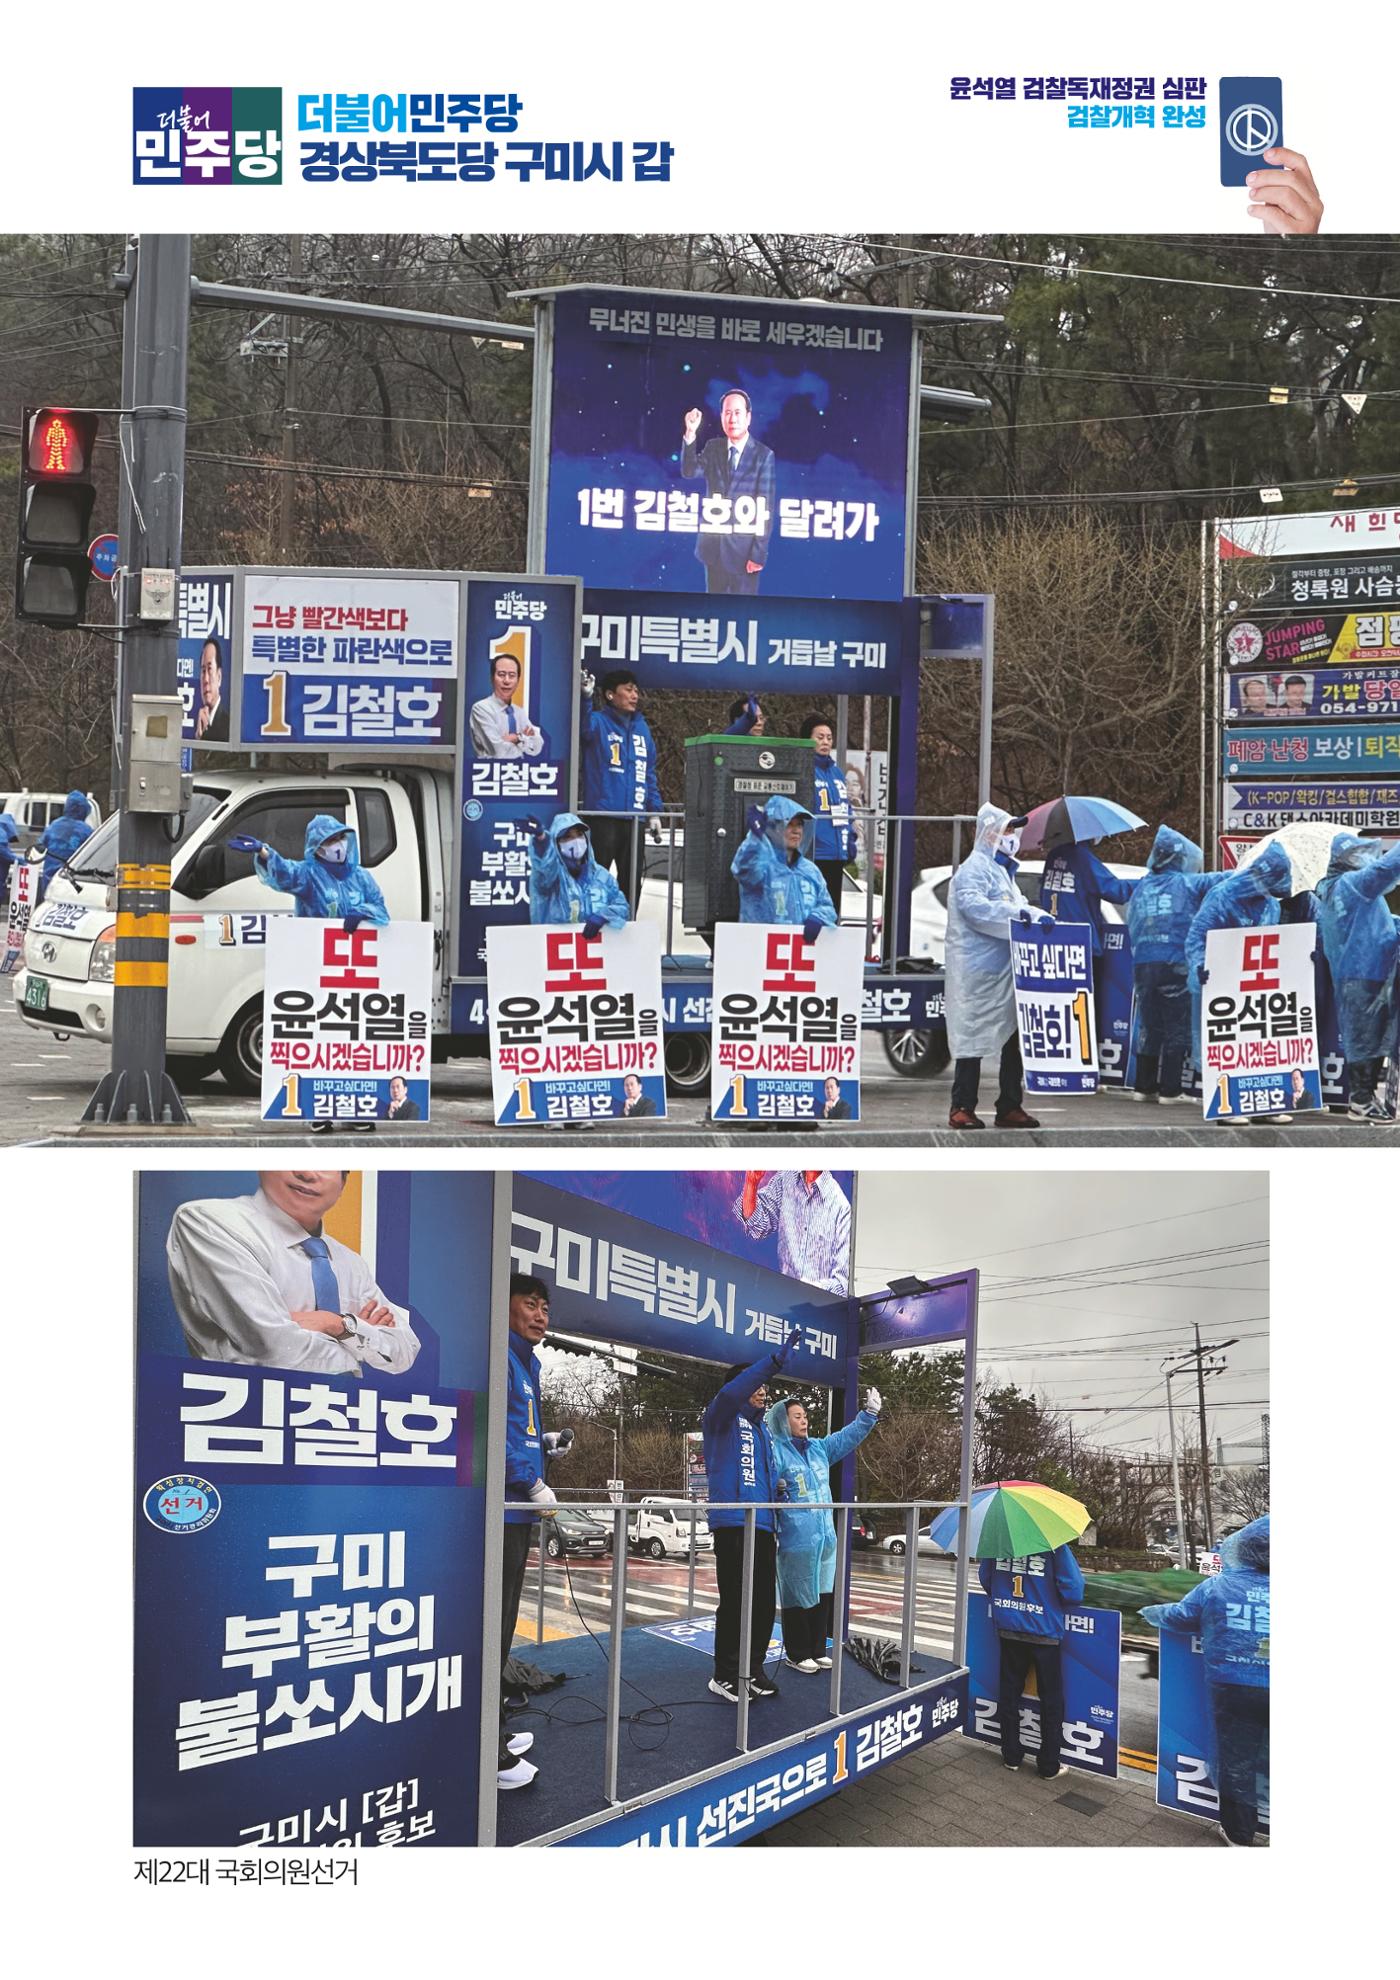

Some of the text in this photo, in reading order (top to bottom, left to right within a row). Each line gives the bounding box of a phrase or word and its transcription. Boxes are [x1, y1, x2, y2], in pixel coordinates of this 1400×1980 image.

[589, 307, 884, 352] 무너진 민생을 바로 세우겠습니다
[577, 487, 880, 542] 1번 김철호와 달려가
[1291, 578, 1349, 602] 청록원
[252, 604, 409, 632] 그냥 빨간색보다
[495, 600, 548, 621] 민주당
[580, 614, 887, 669] 구미특별시 거듭날 구미
[1264, 618, 1326, 647] JUMPING
[252, 635, 453, 667] 특별한 파란색으로
[1264, 641, 1301, 661] STAR
[260, 669, 443, 738] 1 김철호
[1321, 683, 1362, 701] 가발
[609, 742, 622, 767] 1
[1271, 736, 1310, 763] 난청
[1313, 735, 1354, 761] 보상
[471, 762, 559, 797] 김철호
[818, 788, 831, 812] 1
[334, 848, 342, 860] 1
[481, 850, 531, 877] 부활
[218, 913, 237, 946] 1
[319, 927, 380, 990] 또
[545, 931, 608, 993] 또
[762, 932, 817, 993] 또
[1041, 943, 1087, 981] 싶다면
[1239, 933, 1281, 993] 또
[270, 990, 428, 1042] 윤석열을
[495, 992, 659, 1046] 윤석열을
[718, 992, 858, 1044] 윤석열을
[1070, 987, 1093, 1066] 1
[1206, 991, 1314, 1044] 윤석열을
[269, 1041, 426, 1074] 찍으시겠습니까?
[498, 1040, 659, 1076] 찍으시겠습니까?
[717, 1042, 856, 1074] 찍으시겠습니까?
[1206, 1037, 1314, 1072] 찍으시겠습니까?
[281, 1072, 303, 1118] 1
[313, 1094, 379, 1118] 김철호
[512, 1077, 537, 1121] 1
[546, 1093, 614, 1119] 김철호
[728, 1073, 749, 1117] 1
[756, 1093, 816, 1118] 김철호
[1216, 1073, 1234, 1115] 1
[1238, 1088, 1287, 1113] 김철호
[510, 1210, 737, 1336] 구미특별시
[804, 1326, 839, 1361] 구미
[179, 1371, 459, 1469] 김철호
[794, 1472, 808, 1498] 1
[160, 1496, 203, 1515] 선거
[265, 1530, 407, 1599] 구미
[1012, 1575, 1025, 1599] 1
[221, 1594, 436, 1680] 부활의
[175, 1653, 463, 1773] 불쏘시개
[931, 1698, 960, 1729] 민주당
[696, 1752, 828, 1848] 선진국으로
[831, 1730, 850, 1785] 1
[855, 1703, 923, 1774] 김철호
[362, 1777, 419, 1825] [갑]
